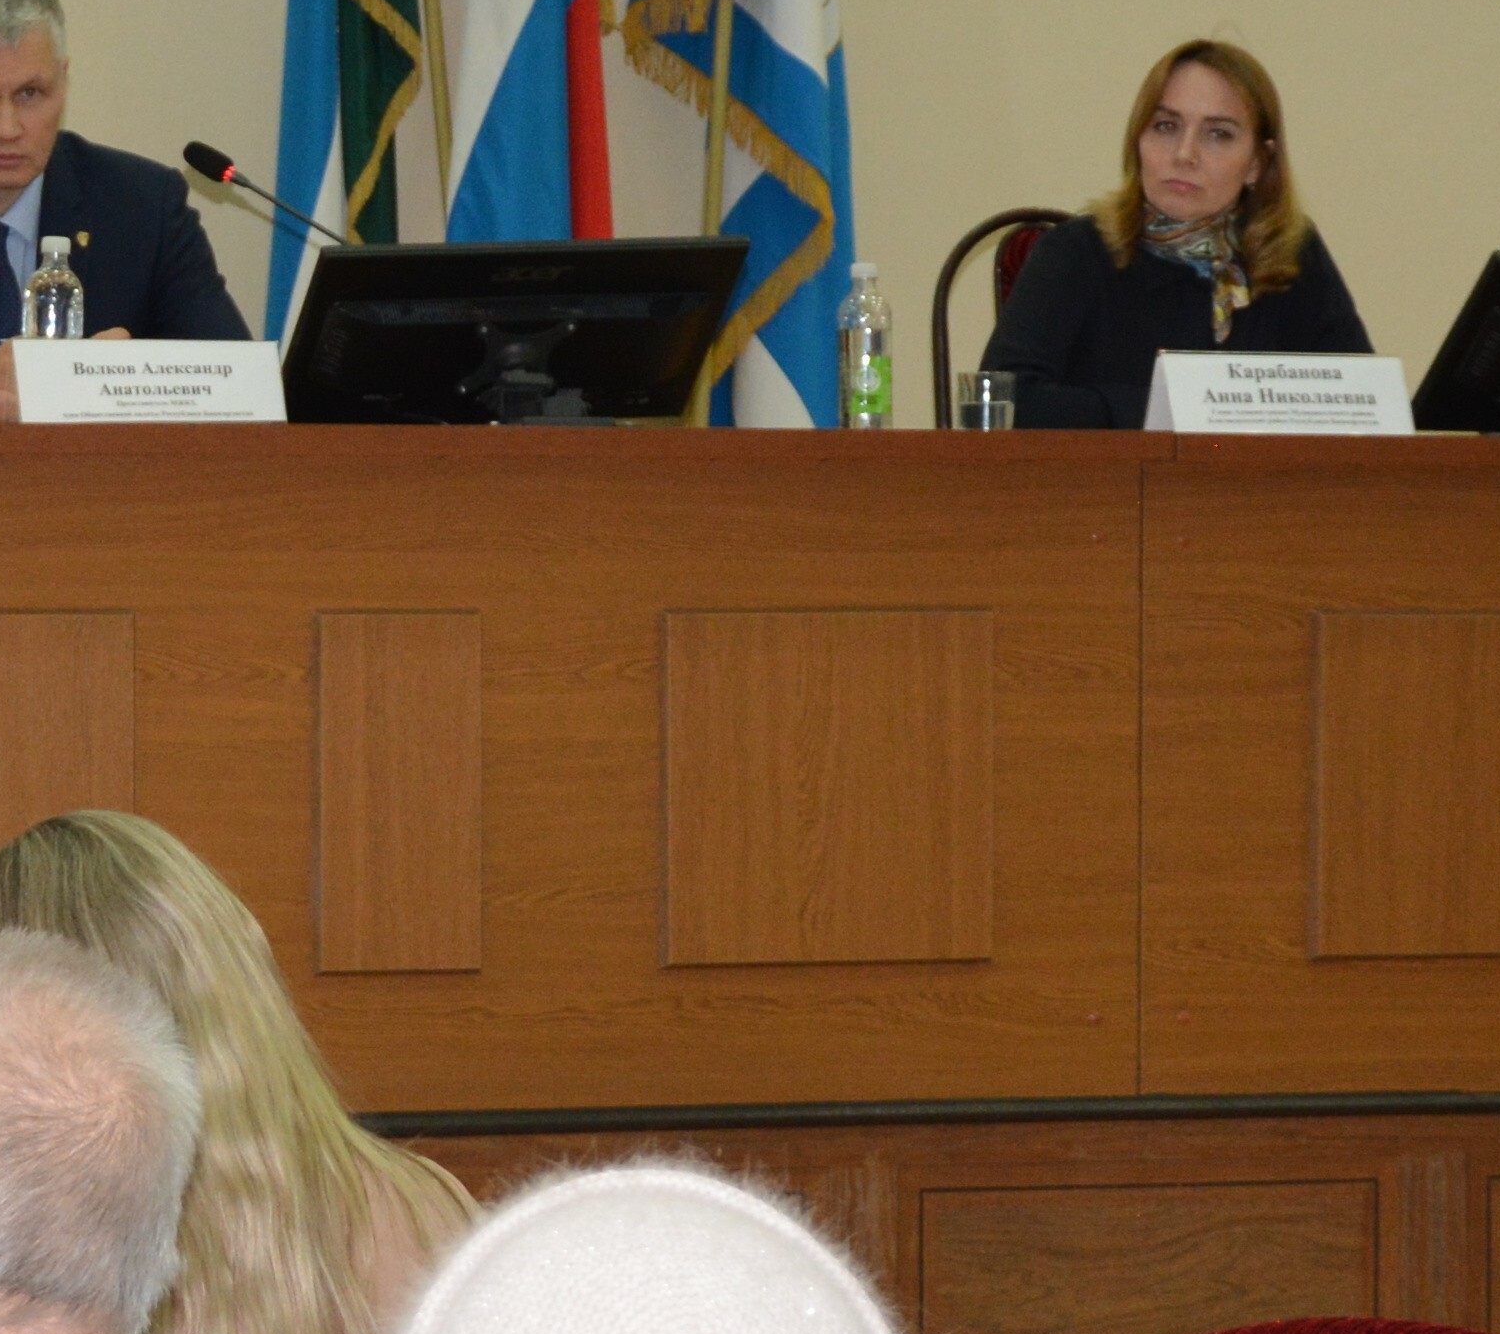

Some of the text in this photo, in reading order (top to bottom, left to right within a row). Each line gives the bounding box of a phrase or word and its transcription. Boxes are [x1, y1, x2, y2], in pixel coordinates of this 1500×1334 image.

[72, 361, 234, 379] Волков Александр
[1227, 362, 1344, 383] Карабанова
[99, 382, 212, 397] Анатольевич
[1203, 387, 1378, 406] Анна Николаевна
